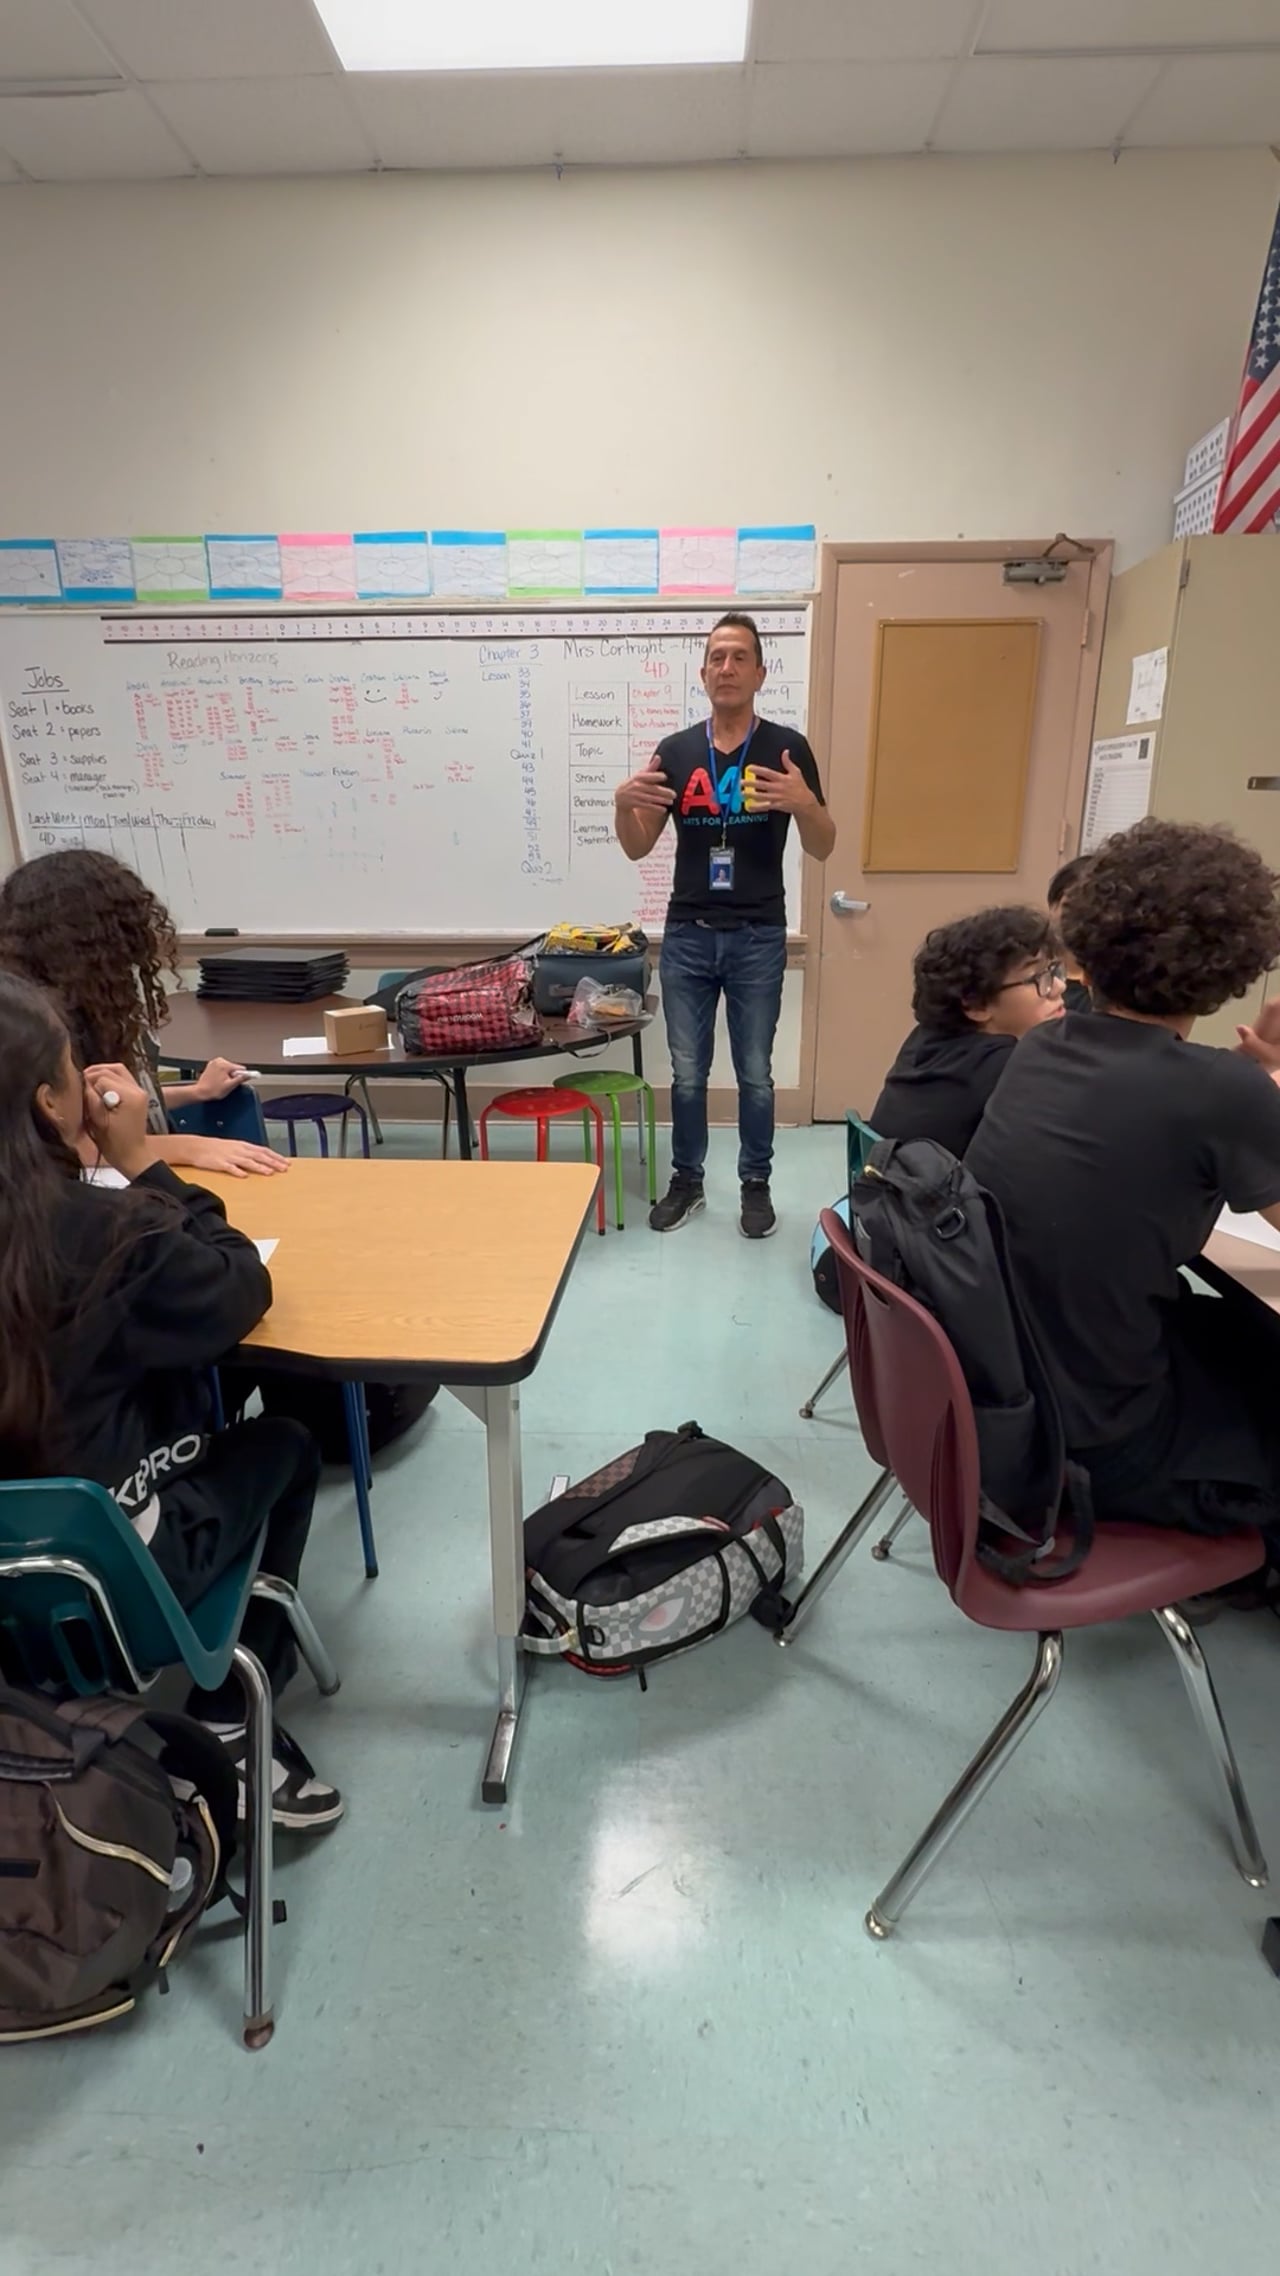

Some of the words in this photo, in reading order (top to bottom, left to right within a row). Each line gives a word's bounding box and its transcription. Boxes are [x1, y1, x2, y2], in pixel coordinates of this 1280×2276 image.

[530, 644, 540, 660] 3
[563, 638, 594, 659] Mrs
[167, 651, 220, 671] Reading
[644, 660, 669, 678] 4D
[24, 666, 64, 688] Jobs
[576, 687, 614, 700] Lesson
[780, 685, 790, 700] 9
[8, 700, 36, 718] Seat
[572, 712, 622, 728] Homework
[12, 724, 38, 741] Seat
[46, 722, 56, 736] 2
[510, 748, 536, 760] Quiz
[576, 743, 604, 757] Topic
[19, 752, 42, 768] Seat
[50, 752, 58, 766] 3
[522, 762, 536, 772] 43
[22, 772, 48, 785] Seat
[50, 771, 60, 783] 4
[575, 772, 606, 784] Strand
[573, 820, 609, 836] Learning
[702, 818, 720, 826] FOR
